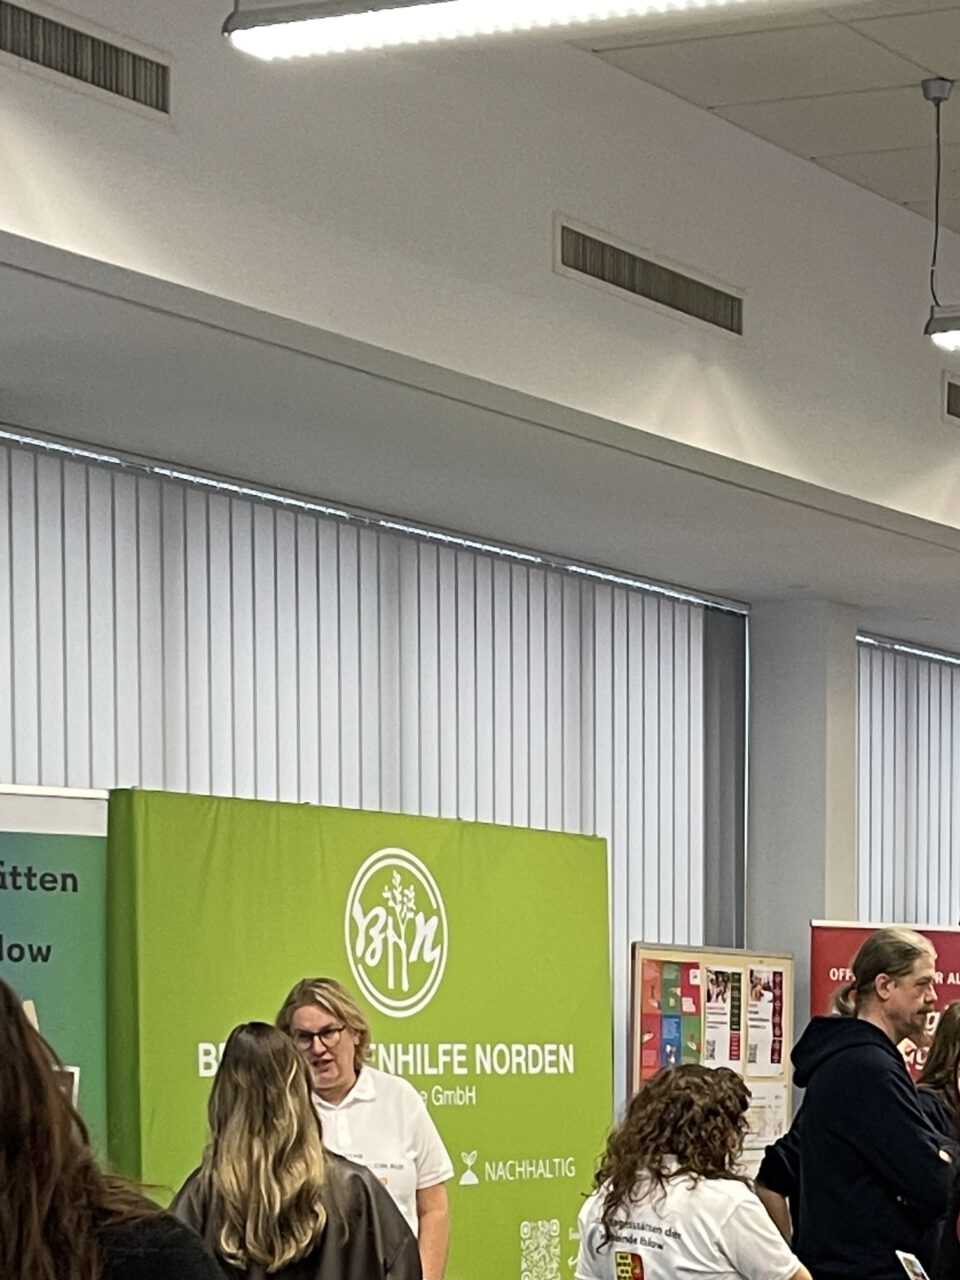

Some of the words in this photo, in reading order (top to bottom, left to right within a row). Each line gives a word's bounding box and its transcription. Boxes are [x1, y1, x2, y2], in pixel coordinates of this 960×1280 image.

[475, 1043, 574, 1075] NORDEN
[431, 1085, 476, 1106] GmbH
[485, 1157, 576, 1181] NACHHALTIG
